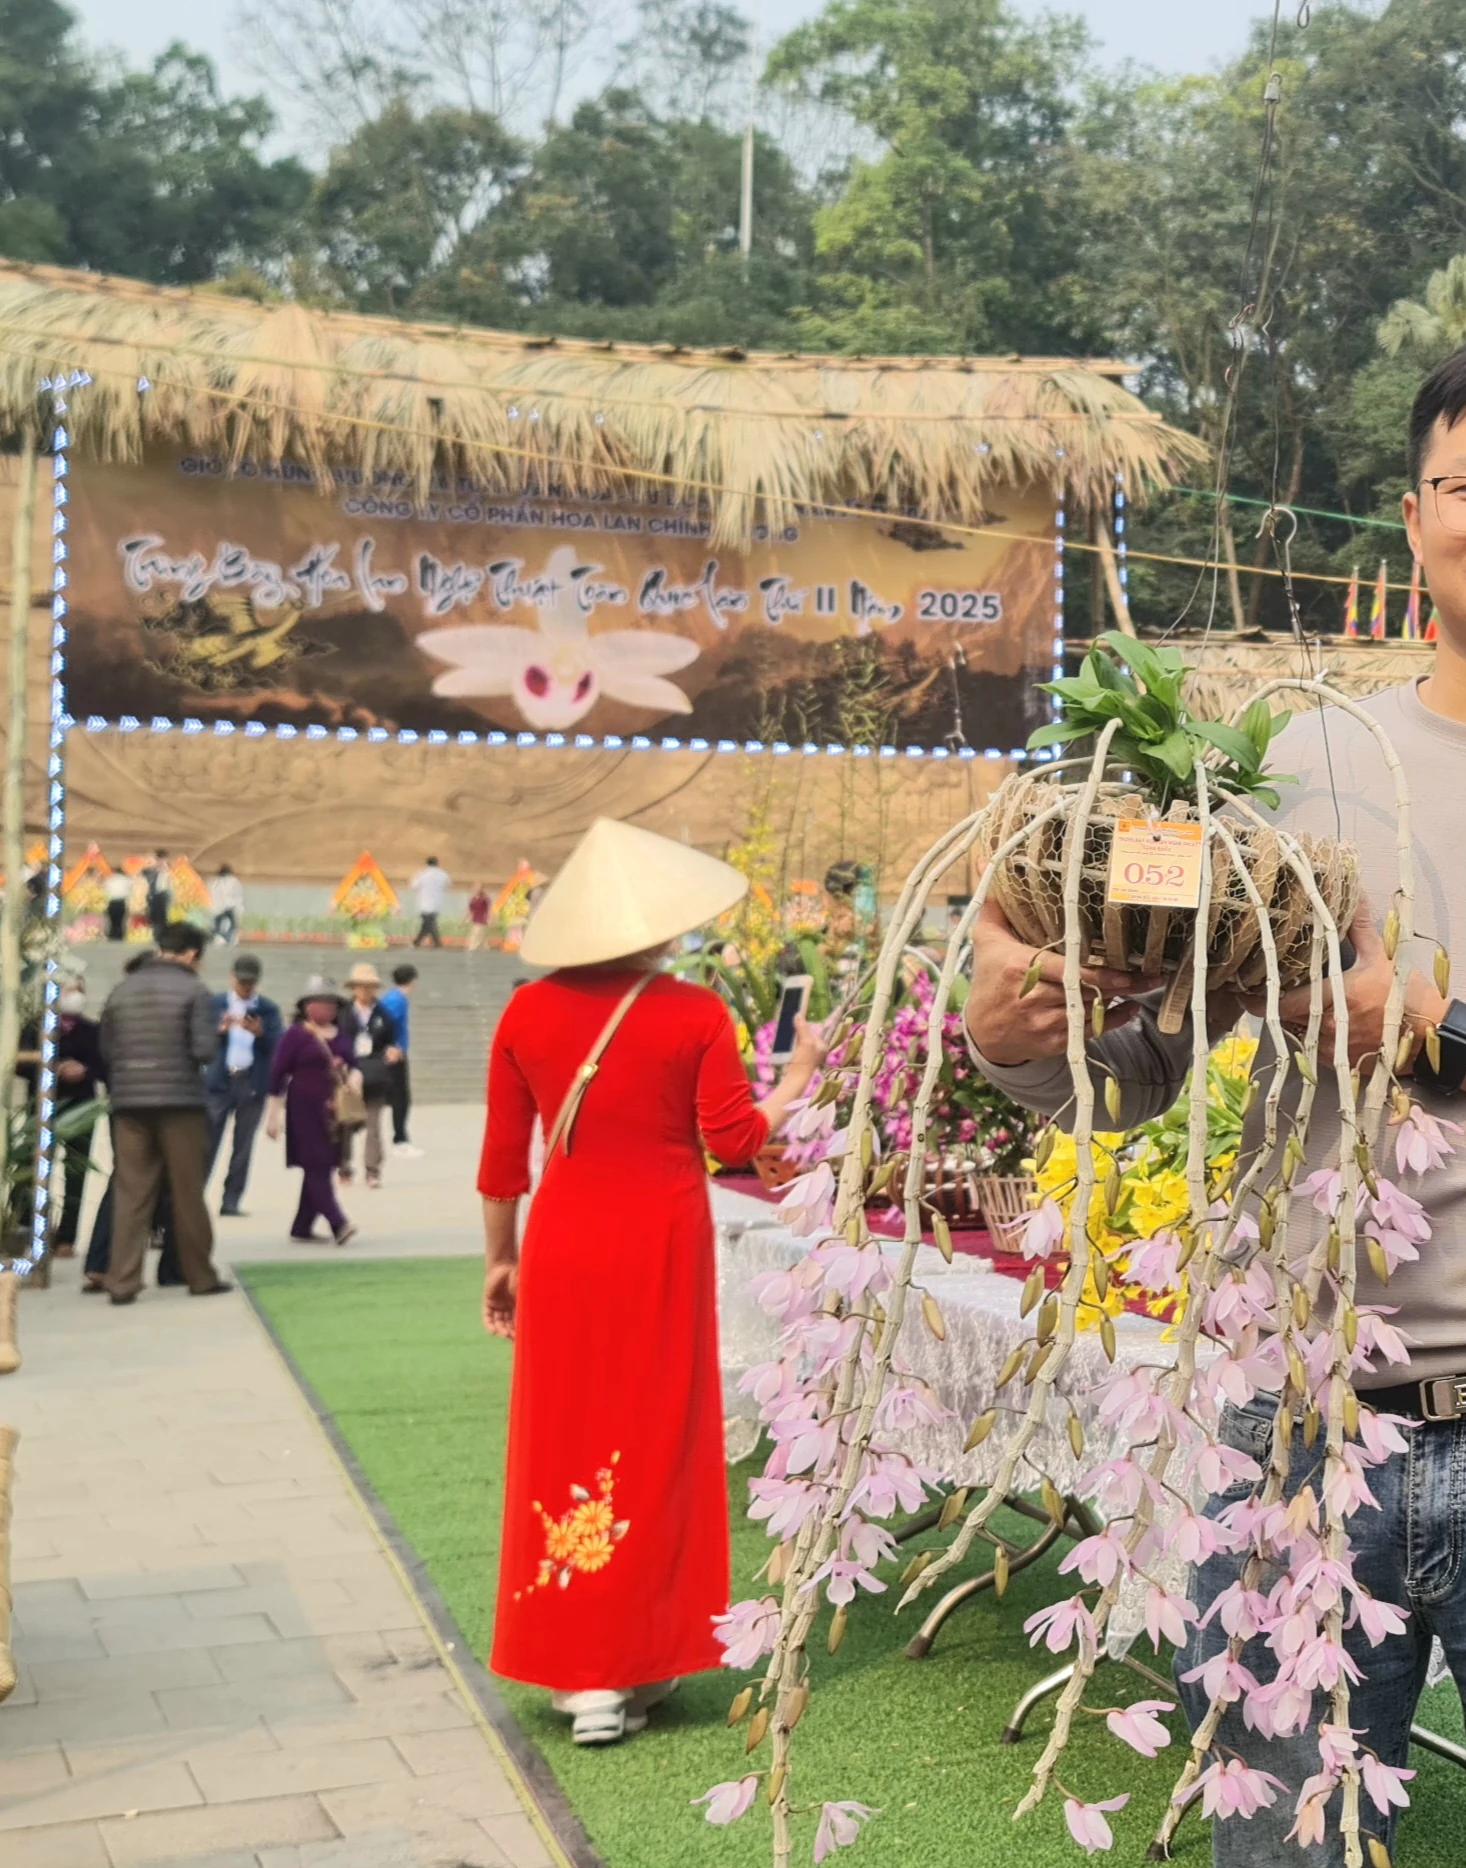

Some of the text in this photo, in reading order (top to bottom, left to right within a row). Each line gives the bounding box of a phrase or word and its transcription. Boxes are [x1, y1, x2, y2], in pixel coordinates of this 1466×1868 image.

[346, 496, 412, 517] CÔNG
[551, 509, 598, 529] HOA
[603, 514, 642, 531] LAN
[918, 590, 1001, 620] 2025
[1123, 862, 1186, 888] 052
